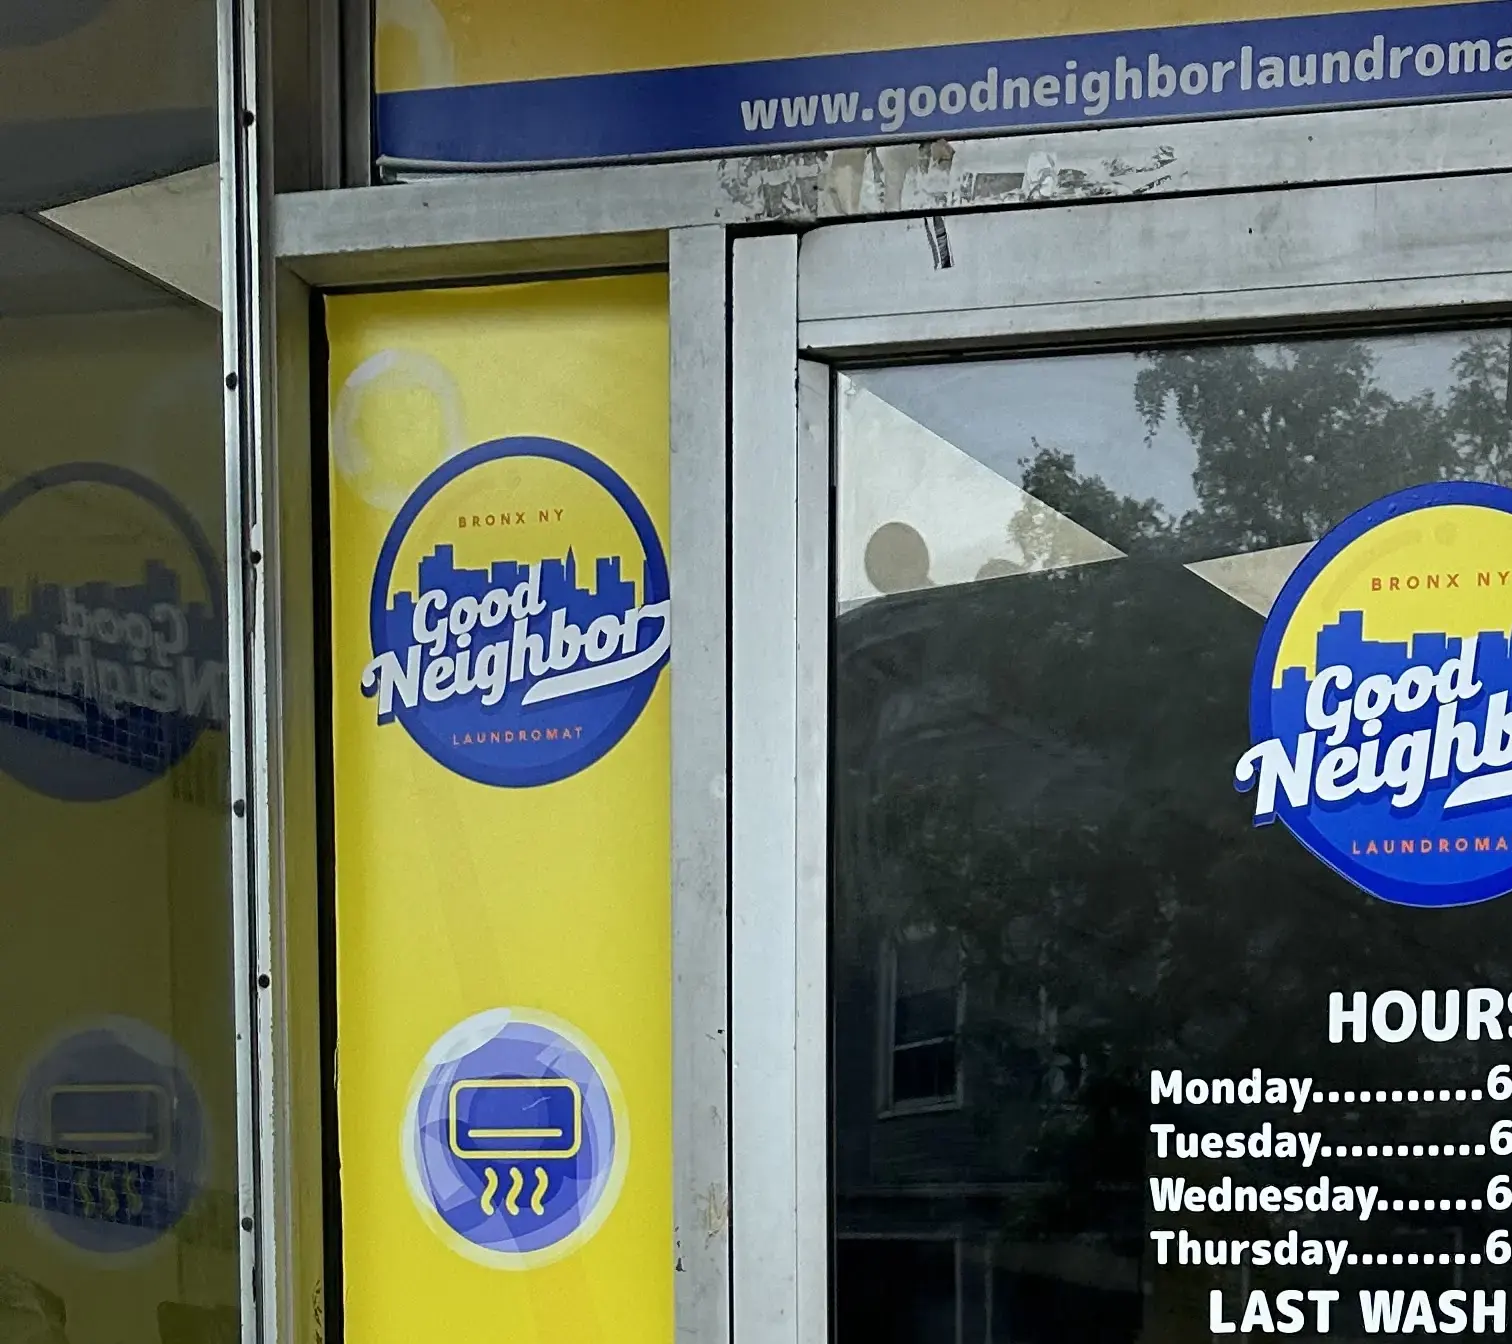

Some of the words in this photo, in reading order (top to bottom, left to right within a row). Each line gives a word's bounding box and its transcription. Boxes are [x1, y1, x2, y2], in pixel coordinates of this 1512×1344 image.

[457, 510, 527, 530] BRONX
[538, 507, 565, 524] NY
[1370, 573, 1461, 593] BRONX
[1477, 570, 1512, 588] NY
[412, 564, 547, 654] Good
[366, 599, 671, 717] Neighbor
[1304, 637, 1483, 744] Good
[451, 726, 585, 747] LAUNDROMAT
[1209, 1289, 1340, 1334] LAST
[1358, 1289, 1507, 1334] WASH
